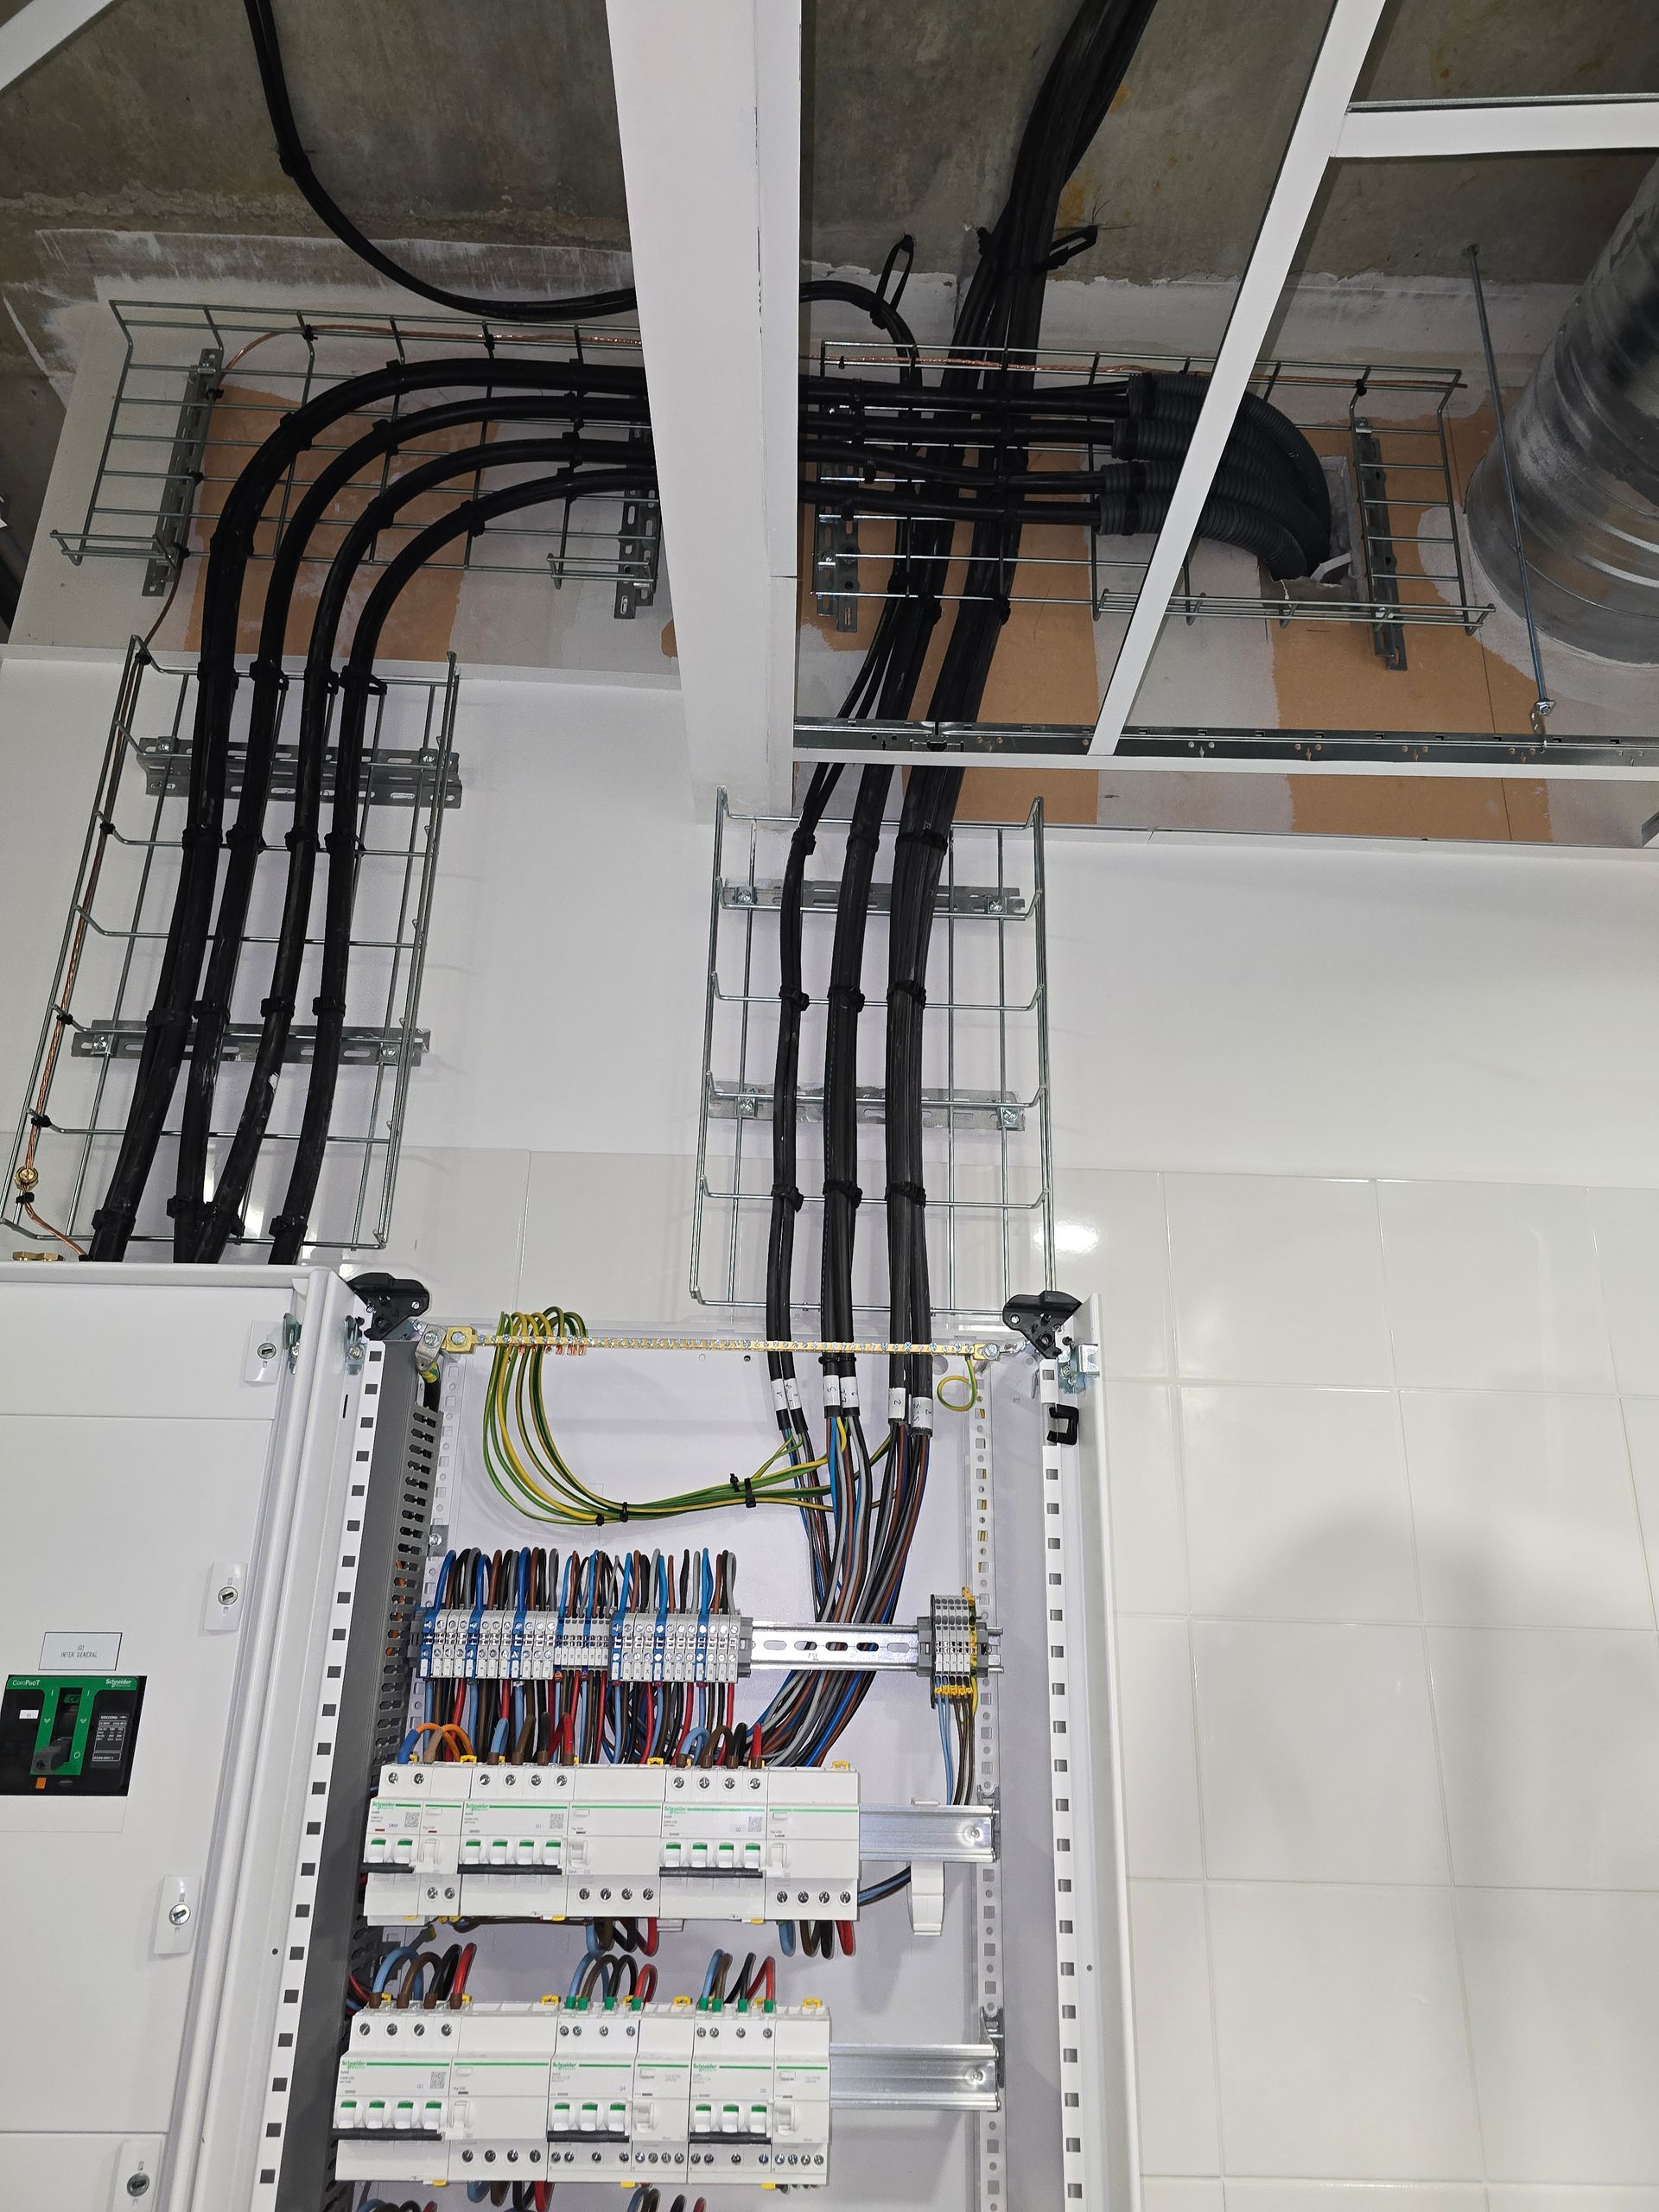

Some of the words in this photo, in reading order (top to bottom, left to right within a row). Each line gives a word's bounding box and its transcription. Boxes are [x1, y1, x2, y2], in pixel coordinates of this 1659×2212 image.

[105, 1678, 131, 1688] Schneider
[372, 1801, 395, 1809] Schneider
[466, 1802, 489, 1811] Schneider
[342, 2060, 366, 2069] Schneider
